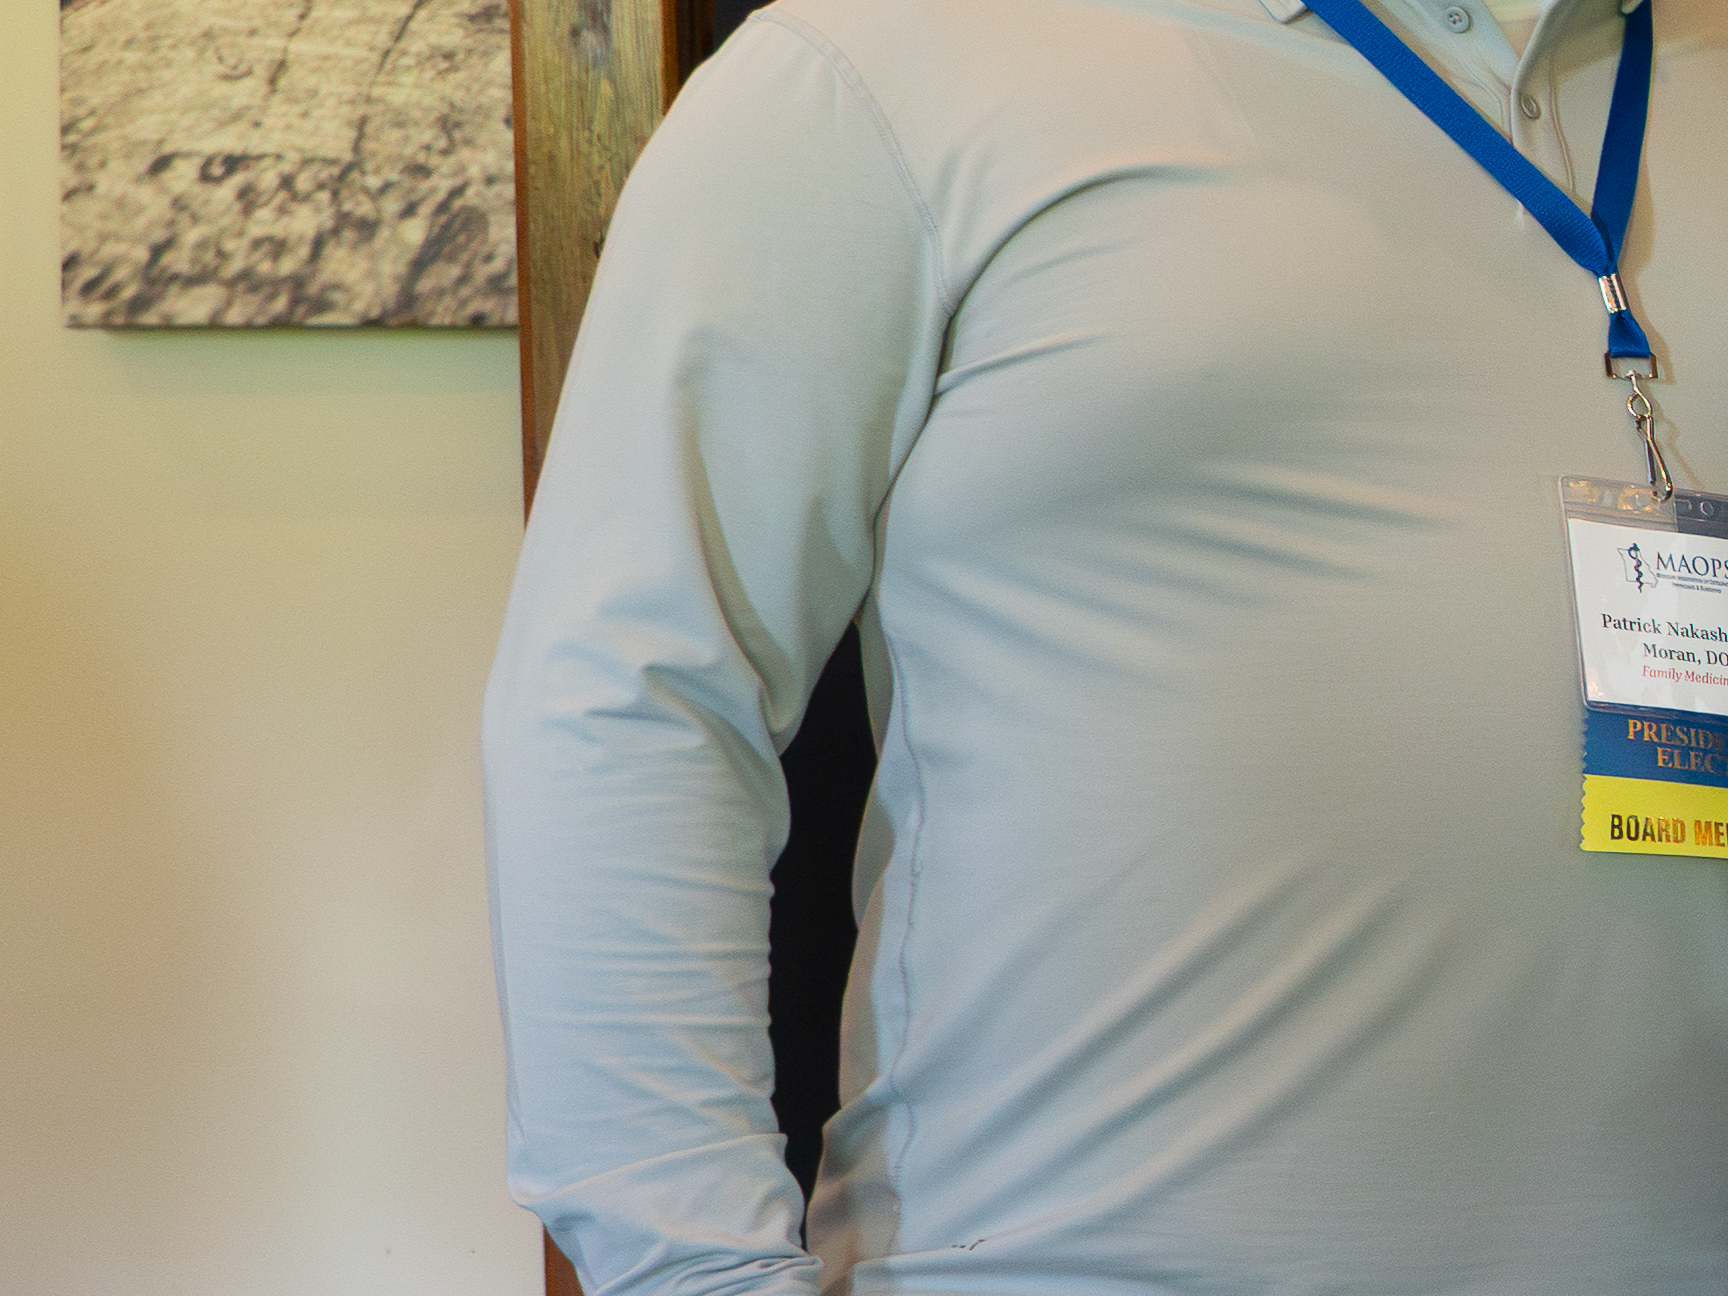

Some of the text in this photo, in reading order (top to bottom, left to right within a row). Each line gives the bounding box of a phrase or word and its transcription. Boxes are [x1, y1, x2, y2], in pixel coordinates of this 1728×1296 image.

[1601, 613, 1662, 635] Patrick
[1642, 643, 1702, 665] Moran,
[1642, 665, 1683, 683] Family
[1610, 814, 1686, 844] BOARD
